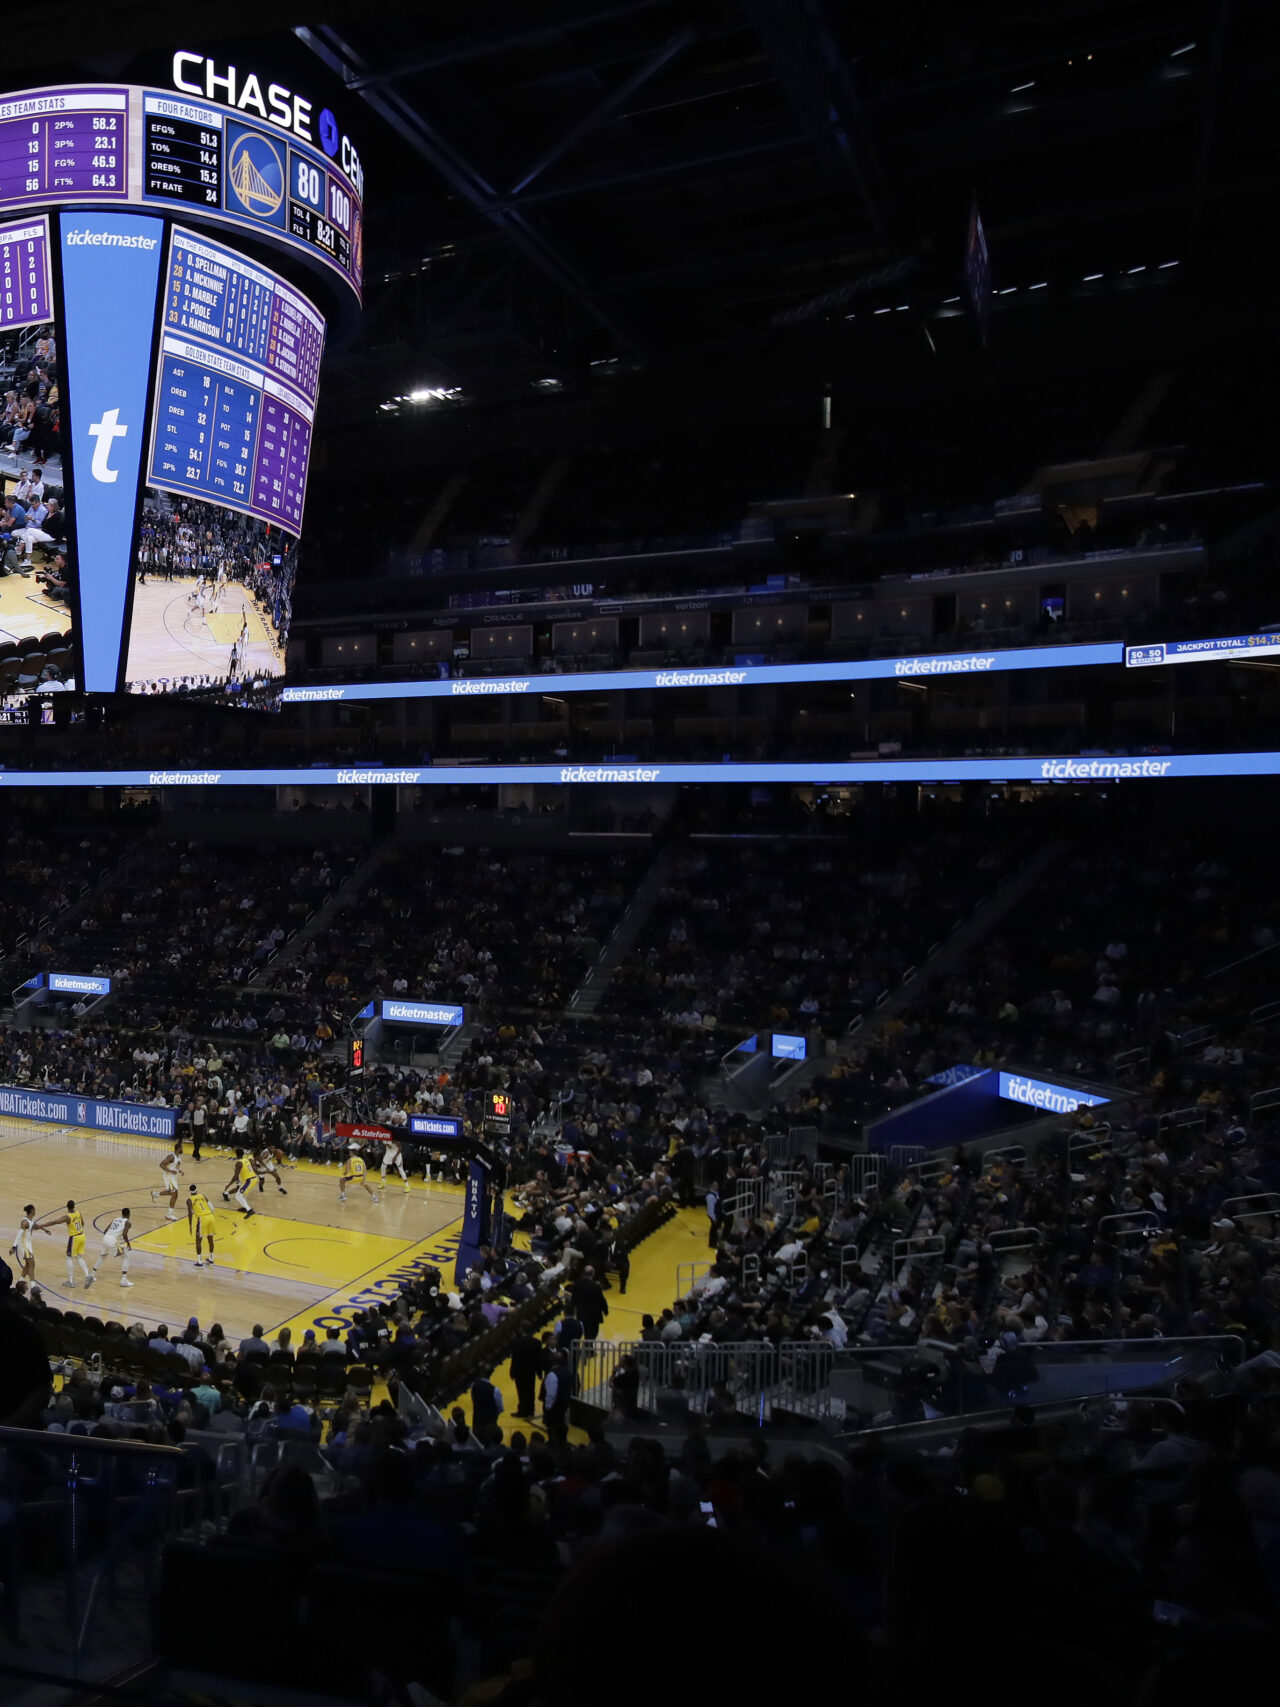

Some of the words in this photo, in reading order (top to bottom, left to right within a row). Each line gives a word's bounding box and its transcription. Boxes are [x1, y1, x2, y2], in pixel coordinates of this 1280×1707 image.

[172, 50, 312, 141] CHASE
[13, 101, 36, 114] TEAM
[37, 97, 65, 110] STATS
[157, 101, 178, 114] FOUR
[180, 105, 213, 124] FACTORS
[32, 122, 39, 135] 0
[54, 121, 74, 130] 2P%
[92, 117, 116, 130] 58.2
[54, 140, 74, 149] 3P%
[94, 136, 116, 149] 23.1
[151, 124, 175, 135] EFG%
[200, 132, 217, 147] 51.3
[28, 141, 39, 154] 13
[151, 142, 170, 153] TO%
[200, 150, 217, 166] 14.4
[28, 160, 39, 173] 15
[54, 159, 75, 168] FG%
[92, 155, 116, 168] 46.9
[54, 178, 73, 187] FT%
[92, 174, 116, 187] 64.3
[151, 162, 181, 174] OREB%
[200, 169, 217, 184] 15.2
[26, 178, 39, 192] 56
[297, 162, 319, 205] 80
[151, 180, 161, 189] FT
[162, 182, 183, 193] RATE
[205, 189, 217, 203] 24
[330, 185, 349, 232] 100
[23, 229, 37, 238] FLS
[66, 229, 157, 250] ticketmaster
[317, 219, 334, 249] 8:21
[195, 257, 227, 280] SPELLMAN
[173, 264, 183, 277] 28
[193, 271, 224, 294] MCKINNIE
[192, 286, 217, 307] MARBLE
[190, 302, 211, 320] POOLE
[189, 317, 220, 339] HARRISON
[185, 346, 206, 362] GOLDEN
[207, 352, 222, 368] STATE
[223, 357, 236, 374] TEAM
[172, 368, 184, 377] AST
[171, 387, 187, 398] OREB
[169, 405, 185, 416] DREB
[88, 408, 128, 483] t
[189, 447, 202, 462] 54.1
[186, 466, 200, 480] 23.7
[483, 612, 524, 624] ORACLE
[1149, 649, 1161, 657] 50
[1176, 642, 1214, 652] JACKPOT
[1216, 639, 1245, 648] TOTAL:
[894, 656, 994, 675] ticketmaster
[655, 670, 747, 686] ticketmaster
[283, 686, 344, 701] cketmaster
[451, 680, 530, 695] ticketmaster
[559, 766, 660, 783] ticketmaster
[1040, 759, 1170, 778] ticketmaster
[149, 772, 221, 785] ticketmaster
[336, 769, 420, 784] ticketmaster
[55, 978, 104, 991] ticketmaster
[389, 1005, 454, 1021] ticketmaster
[495, 1104, 506, 1115] 10
[96, 1105, 172, 1135] NBATickets.com
[414, 1120, 455, 1134] NBATickets.com
[354, 1164, 362, 1172] 19
[470, 1204, 477, 1219] TV
